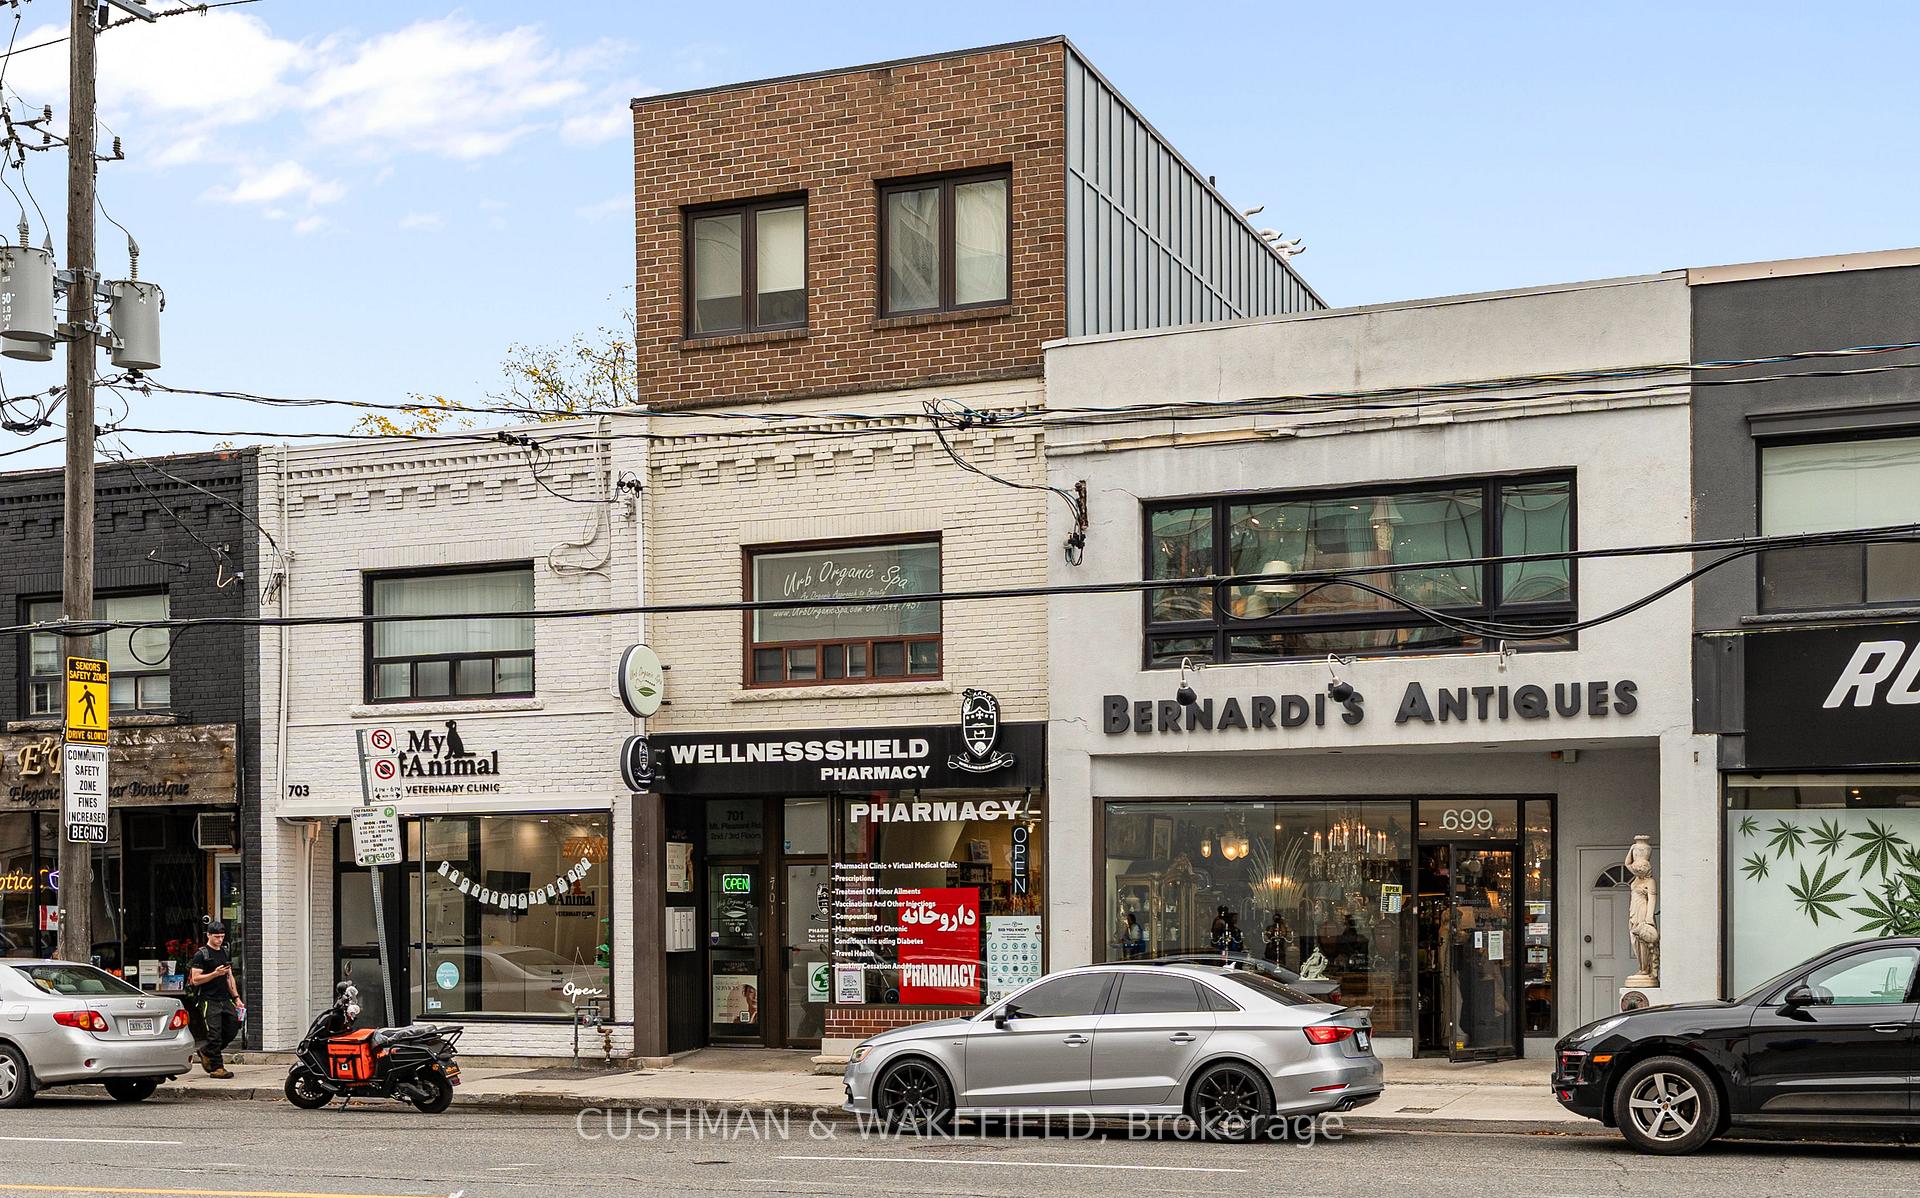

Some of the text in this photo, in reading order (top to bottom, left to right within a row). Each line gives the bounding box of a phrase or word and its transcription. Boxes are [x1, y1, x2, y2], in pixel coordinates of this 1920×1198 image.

[783, 561, 908, 597] Urb Organic Spa
[75, 661, 100, 672] SENIORS
[69, 670, 107, 682] SAFETY ZONE
[1395, 680, 1638, 723] ANTIQUES
[68, 730, 85, 740] DRIVE
[87, 731, 106, 741] SLOWLY
[406, 730, 446, 759] My
[671, 738, 930, 764] WELLNESSSHIELD
[68, 750, 105, 762] COMMUNITY
[74, 764, 100, 776] SAFETY
[406, 750, 500, 777] Animal
[821, 765, 930, 781] PHARMACY
[80, 780, 97, 792] ZONE
[129, 781, 189, 798] Boutique
[288, 784, 310, 797] 703
[406, 783, 500, 794] VETERINARY CLINIC
[78, 797, 98, 808] FINES
[68, 812, 106, 823] INCREASED
[726, 810, 744, 821] 701
[850, 800, 1021, 823] PHARMACY
[1443, 809, 1492, 830] 699
[72, 826, 104, 840] BEGINS
[1014, 827, 1027, 894] OPEN
[725, 878, 748, 890] OPEN
[902, 903, 976, 932] داروخانه
[867, 938, 895, 946] Incuding
[903, 964, 976, 987] PHARMACY
[563, 982, 602, 1004] Open
